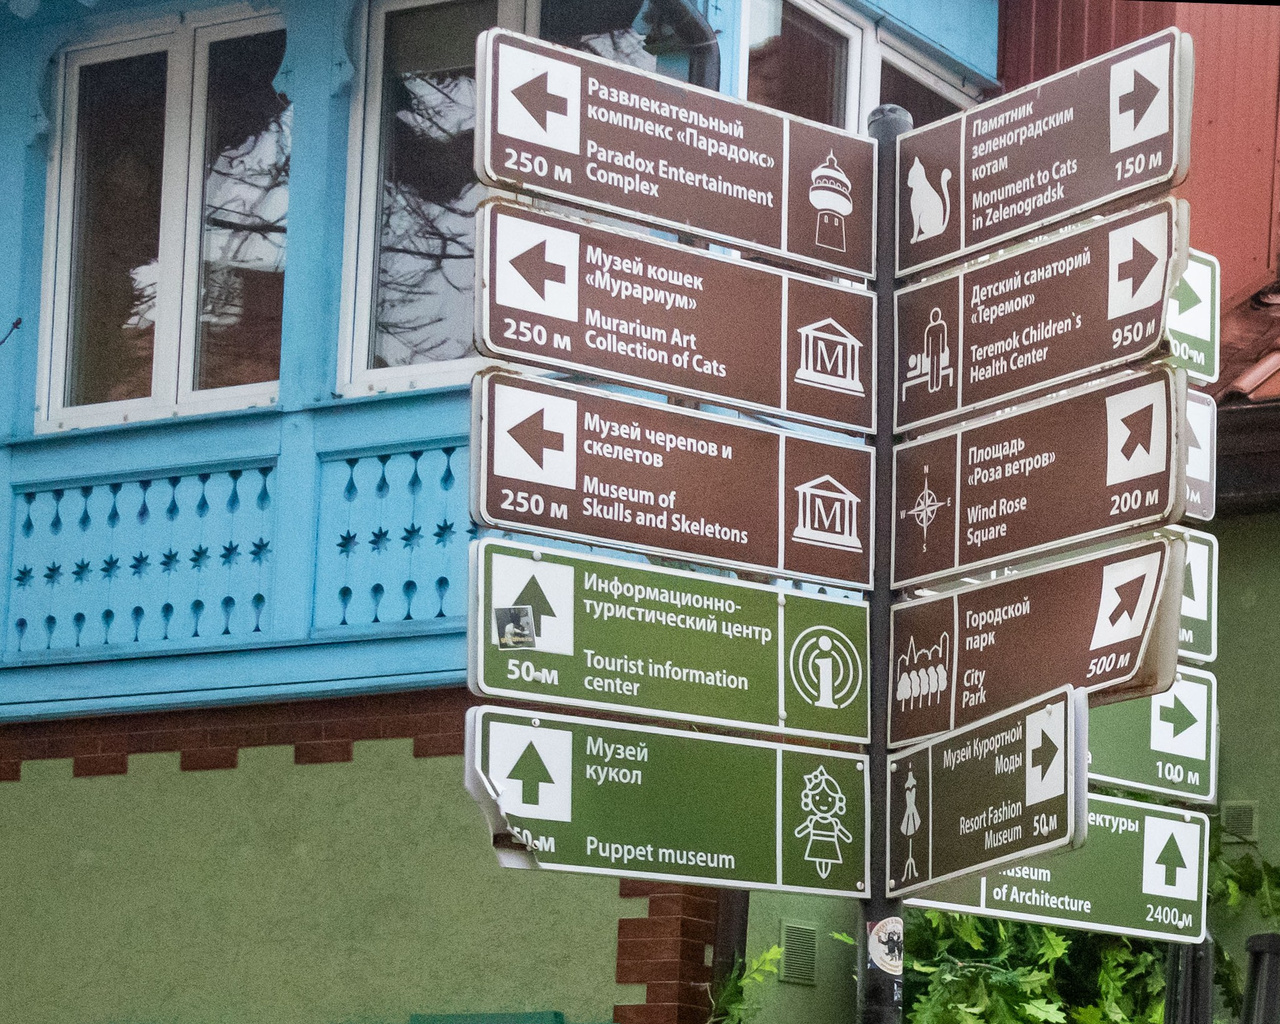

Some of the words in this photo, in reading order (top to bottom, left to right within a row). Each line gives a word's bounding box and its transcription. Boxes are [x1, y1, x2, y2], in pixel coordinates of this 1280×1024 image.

[588, 77, 744, 139] Развлекательный
[972, 102, 1033, 138] Памятник
[588, 104, 673, 142] комплекс
[677, 131, 775, 169] «Парадокс»
[972, 107, 1074, 159] зеленоградским
[505, 148, 548, 177] 250
[587, 140, 655, 175] Paradox
[659, 159, 774, 208] Entertainment
[972, 156, 1008, 181] котам
[1115, 155, 1146, 181] 150
[587, 163, 660, 198] Complex
[972, 176, 1034, 210] Monument
[1037, 171, 1049, 185] to
[1052, 157, 1077, 180] Cats
[972, 213, 983, 231] in
[986, 183, 1065, 228] Zelenogradsk
[586, 246, 643, 279] Музей
[647, 264, 703, 290] кошек
[971, 271, 1021, 307] Детский
[1024, 247, 1090, 285] санаторий
[586, 273, 697, 311] «Мурариум»
[971, 293, 1035, 325] «Теремок»
[504, 318, 547, 346] 250
[585, 308, 667, 344] Murarium
[671, 328, 696, 350] Art
[1112, 322, 1143, 349] 950
[585, 330, 668, 366] Collection
[672, 349, 689, 369] of
[692, 354, 726, 378] Cats
[970, 335, 1019, 362] Teremok
[1171, 339, 1189, 360] 00
[970, 356, 1008, 384] Health
[1010, 345, 1048, 370] Center
[584, 412, 642, 441] Музей
[645, 427, 718, 458] черепов
[722, 444, 732, 460] и
[584, 438, 664, 468] скелетов
[969, 438, 1024, 465] Площадь
[968, 465, 1002, 487] «Роза
[1004, 451, 1055, 478] ветров»
[501, 489, 544, 515] 250
[584, 475, 654, 505] Museum
[659, 490, 676, 508] of
[1110, 491, 1141, 516] 200
[583, 498, 631, 524] Skulls
[636, 510, 667, 530] and
[671, 514, 748, 544] Skeletons
[968, 503, 997, 523] Wind
[1000, 496, 1027, 516] Rose
[967, 523, 1007, 546] Square
[584, 572, 741, 614] Информационно-
[584, 599, 717, 634] туристический
[721, 619, 772, 644] центр
[966, 597, 1030, 629] Городской
[966, 633, 995, 651] парк
[507, 660, 534, 682] 50
[584, 650, 644, 675] Tourist
[648, 657, 748, 691] information
[964, 668, 985, 689] City
[1087, 654, 1114, 678] 500
[584, 677, 640, 696] center
[962, 688, 986, 708] Park
[586, 736, 648, 762] Музей
[943, 742, 971, 769] Музей
[973, 722, 1022, 757] Курортной
[586, 762, 642, 785] кукол
[995, 751, 1022, 775] Моды
[1156, 761, 1184, 783] 100
[960, 809, 986, 836] Resort
[988, 801, 1022, 826] Fashion
[1033, 814, 1047, 836] 50
[1088, 813, 1139, 833] ектуры
[985, 823, 1022, 850] Museum
[587, 836, 654, 863] Puppet
[658, 849, 735, 869] museum
[998, 866, 1051, 882] useum
[993, 884, 1008, 901] of
[1010, 886, 1091, 913] Architecture
[1146, 904, 1178, 925] 2400
